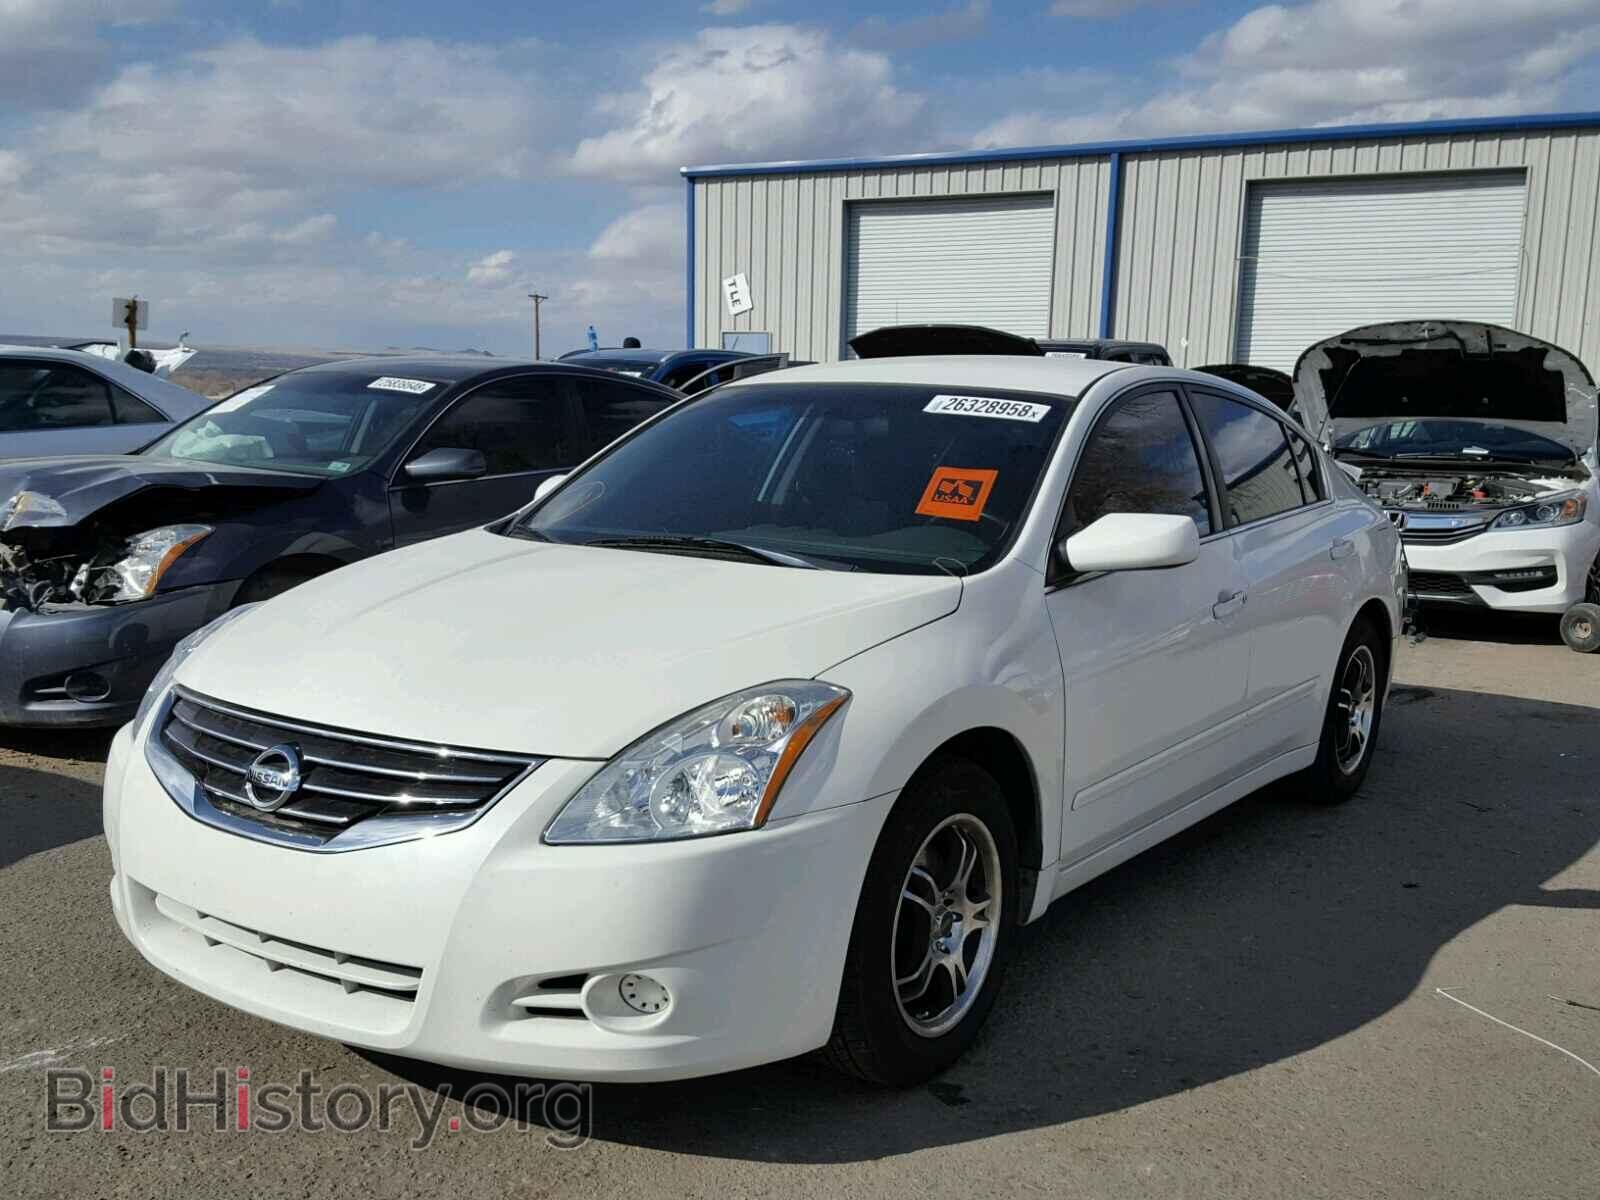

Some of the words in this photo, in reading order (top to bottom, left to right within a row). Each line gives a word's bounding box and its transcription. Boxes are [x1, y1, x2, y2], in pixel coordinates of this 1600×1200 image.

[728, 279, 742, 308] TLE
[934, 494, 969, 505] USAA
[248, 767, 289, 787] NISSAN
